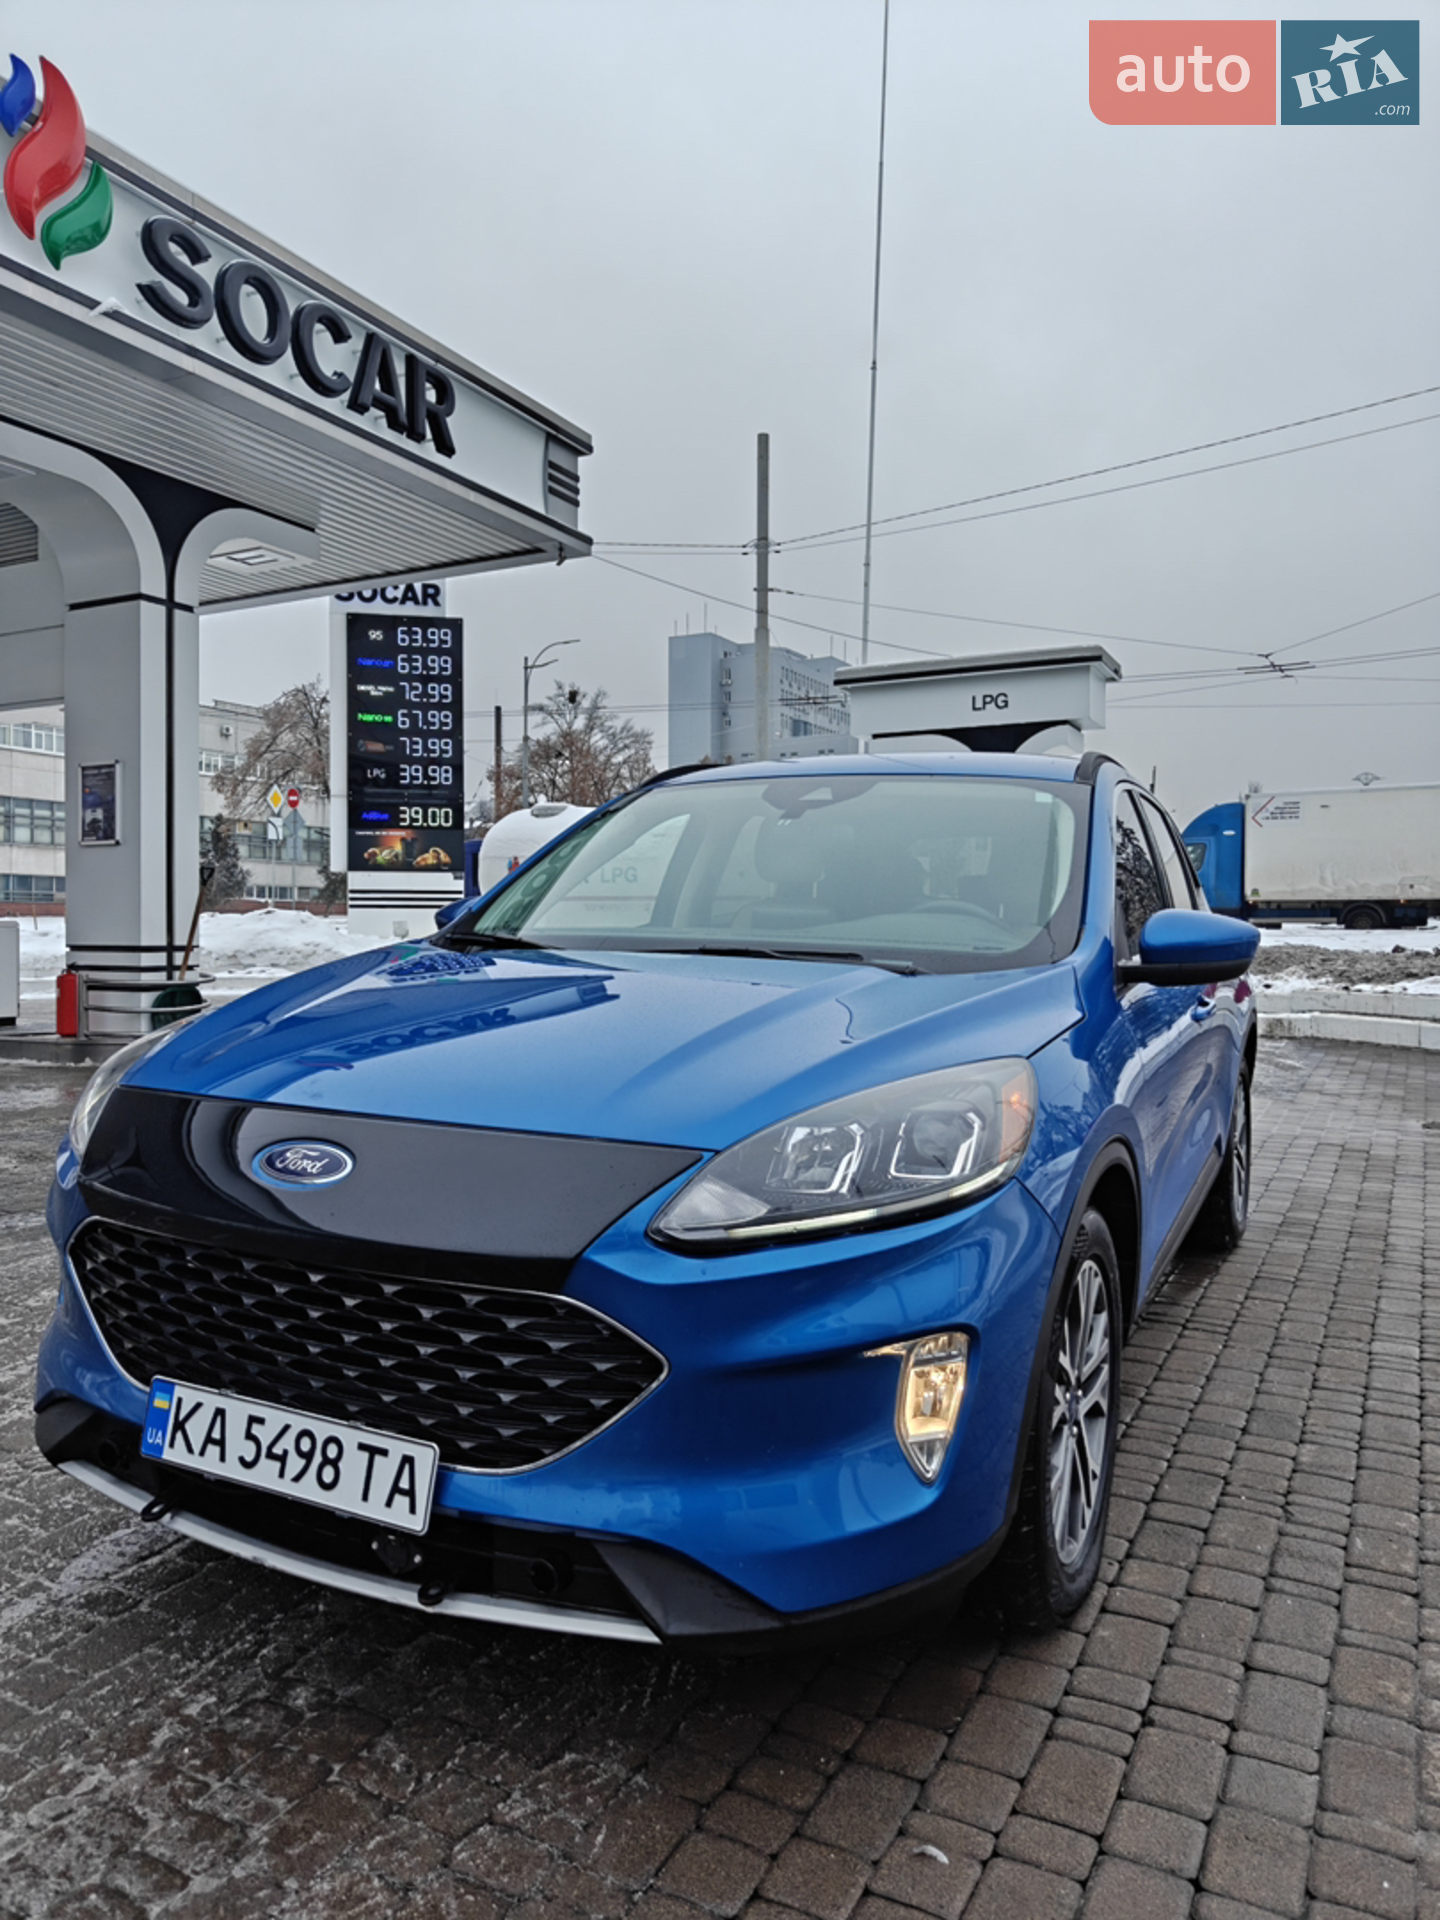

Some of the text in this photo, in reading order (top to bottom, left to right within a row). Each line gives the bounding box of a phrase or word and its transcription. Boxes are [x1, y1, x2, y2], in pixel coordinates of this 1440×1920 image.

[136, 214, 456, 458] SOCAR
[368, 626, 452, 648] 95 63.99
[397, 653, 452, 676] 63.99
[399, 681, 452, 703] 72.99
[972, 692, 1009, 712] LPG
[397, 709, 453, 731] 67.99
[399, 736, 453, 758] 73.99
[367, 764, 453, 785] LPG 39.98
[399, 806, 453, 828] 39.00
[600, 866, 639, 884] LPG
[275, 1147, 330, 1174] Ford
[146, 1426, 163, 1446] UA
[168, 1397, 417, 1515] KA 5498 TA
